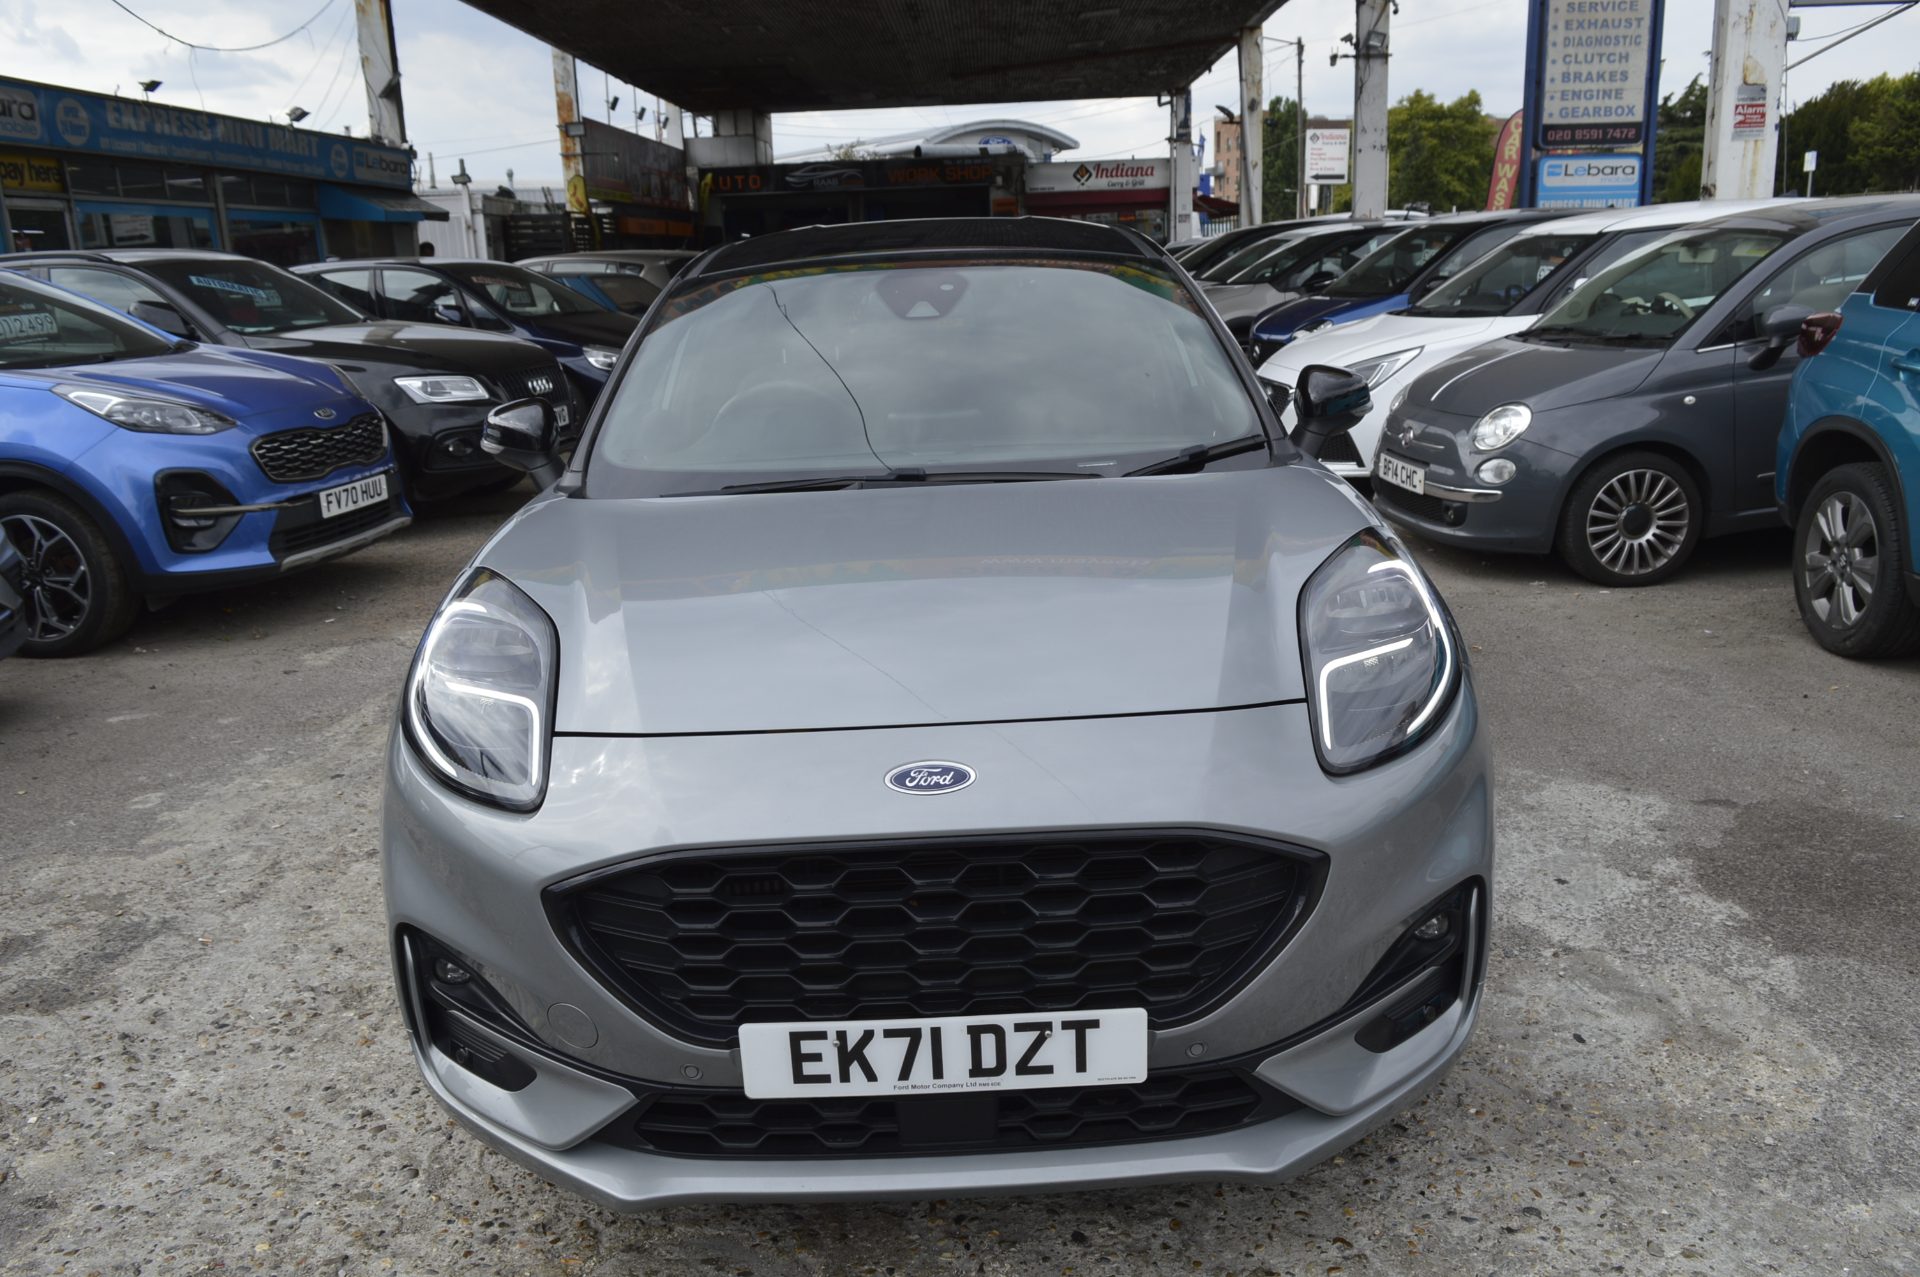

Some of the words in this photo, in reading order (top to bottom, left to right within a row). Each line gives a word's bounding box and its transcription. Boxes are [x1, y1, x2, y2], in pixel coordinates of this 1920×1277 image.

[1566, 0, 1639, 13] SERVICE
[1564, 17, 1644, 31] EXHAUST
[1563, 34, 1643, 48] DIAGNOSTIC
[1562, 52, 1630, 65] CLUTCH
[1561, 70, 1629, 83] BRAKES
[1560, 89, 1624, 101] ENGINE
[1559, 105, 1636, 119] GEARBOX
[1735, 104, 1767, 114] Alarm
[105, 99, 212, 141] EXPRESS
[216, 117, 264, 149] MINI
[267, 126, 319, 159] MART
[1547, 129, 1571, 141] 020
[1575, 128, 1602, 140] 8591
[1607, 127, 1637, 139] 7472
[366, 151, 408, 175] Lebara
[1564, 163, 1635, 177] Lebara
[28, 158, 62, 183] here
[888, 166, 940, 184] WORK
[944, 164, 992, 181] SHOP
[1093, 162, 1155, 179] Indiana
[1493, 163, 1516, 210] WAS
[1383, 457, 1399, 481] BF14
[1400, 465, 1417, 489] CHC
[325, 486, 358, 512] FV70
[360, 478, 382, 502] HUU
[905, 768, 954, 787] Ford
[789, 1027, 944, 1084] EK71
[967, 1019, 1100, 1078] DZT
[932, 1081, 964, 1091] Company
